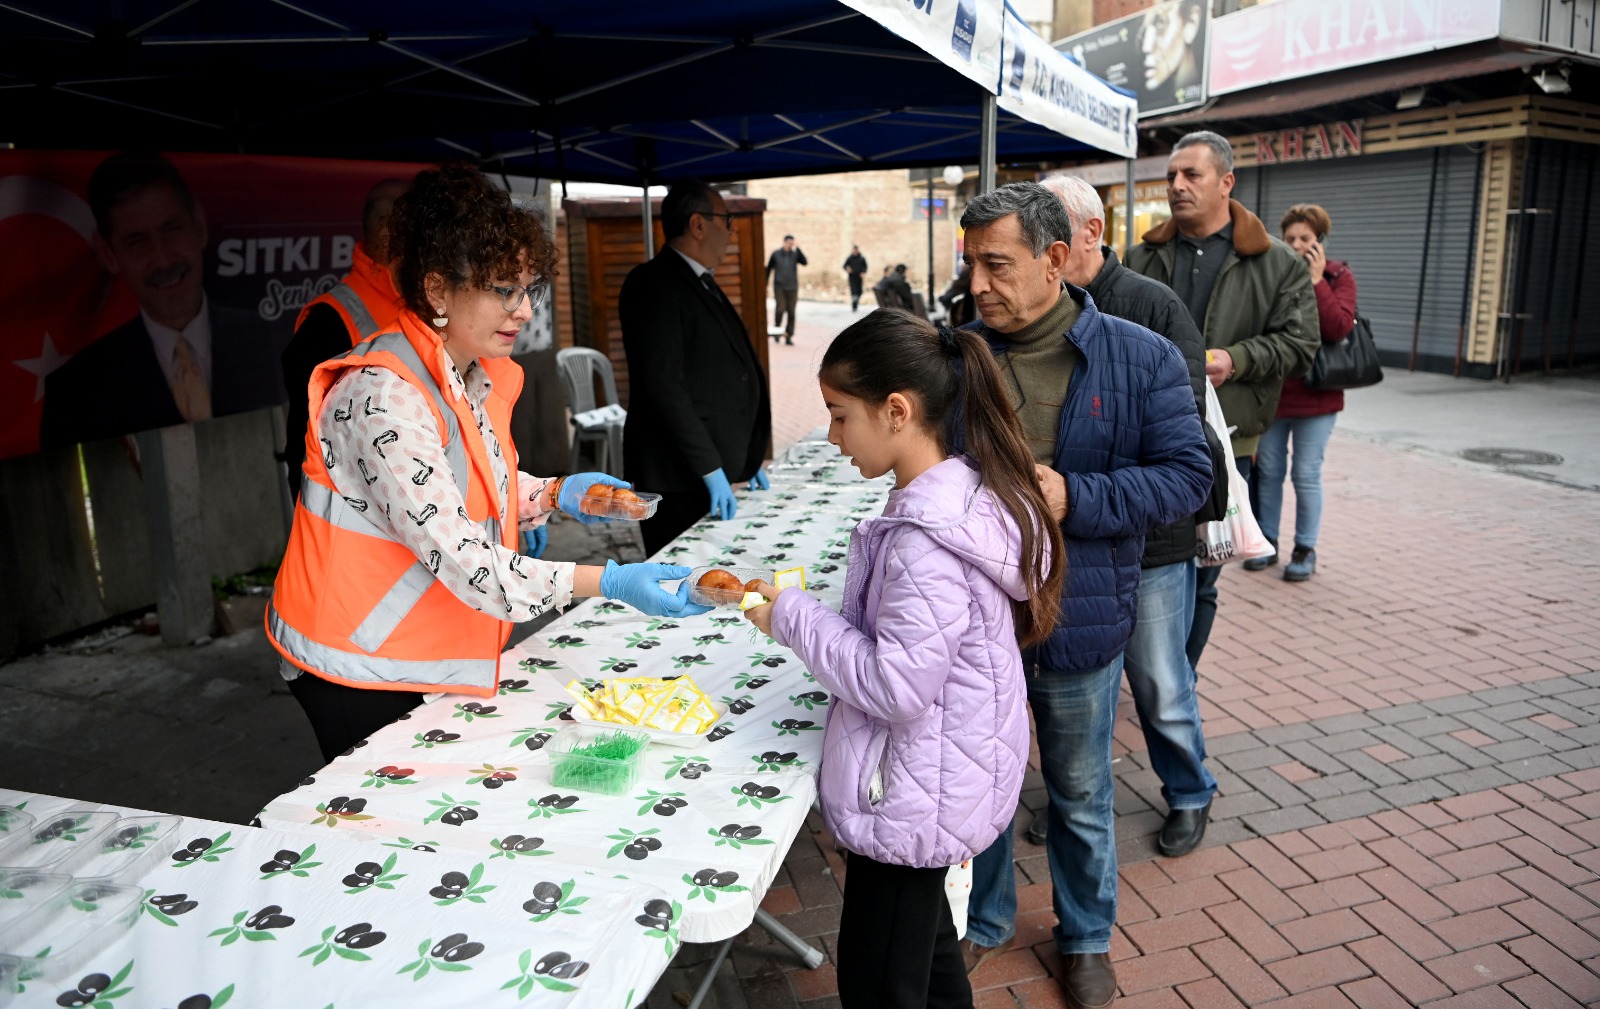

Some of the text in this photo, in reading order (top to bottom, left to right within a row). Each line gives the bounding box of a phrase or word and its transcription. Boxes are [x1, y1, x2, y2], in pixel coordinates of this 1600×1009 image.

[1281, 0, 1436, 63] KHAN
[1254, 119, 1363, 164] KHAN
[217, 237, 319, 276] SITKI
